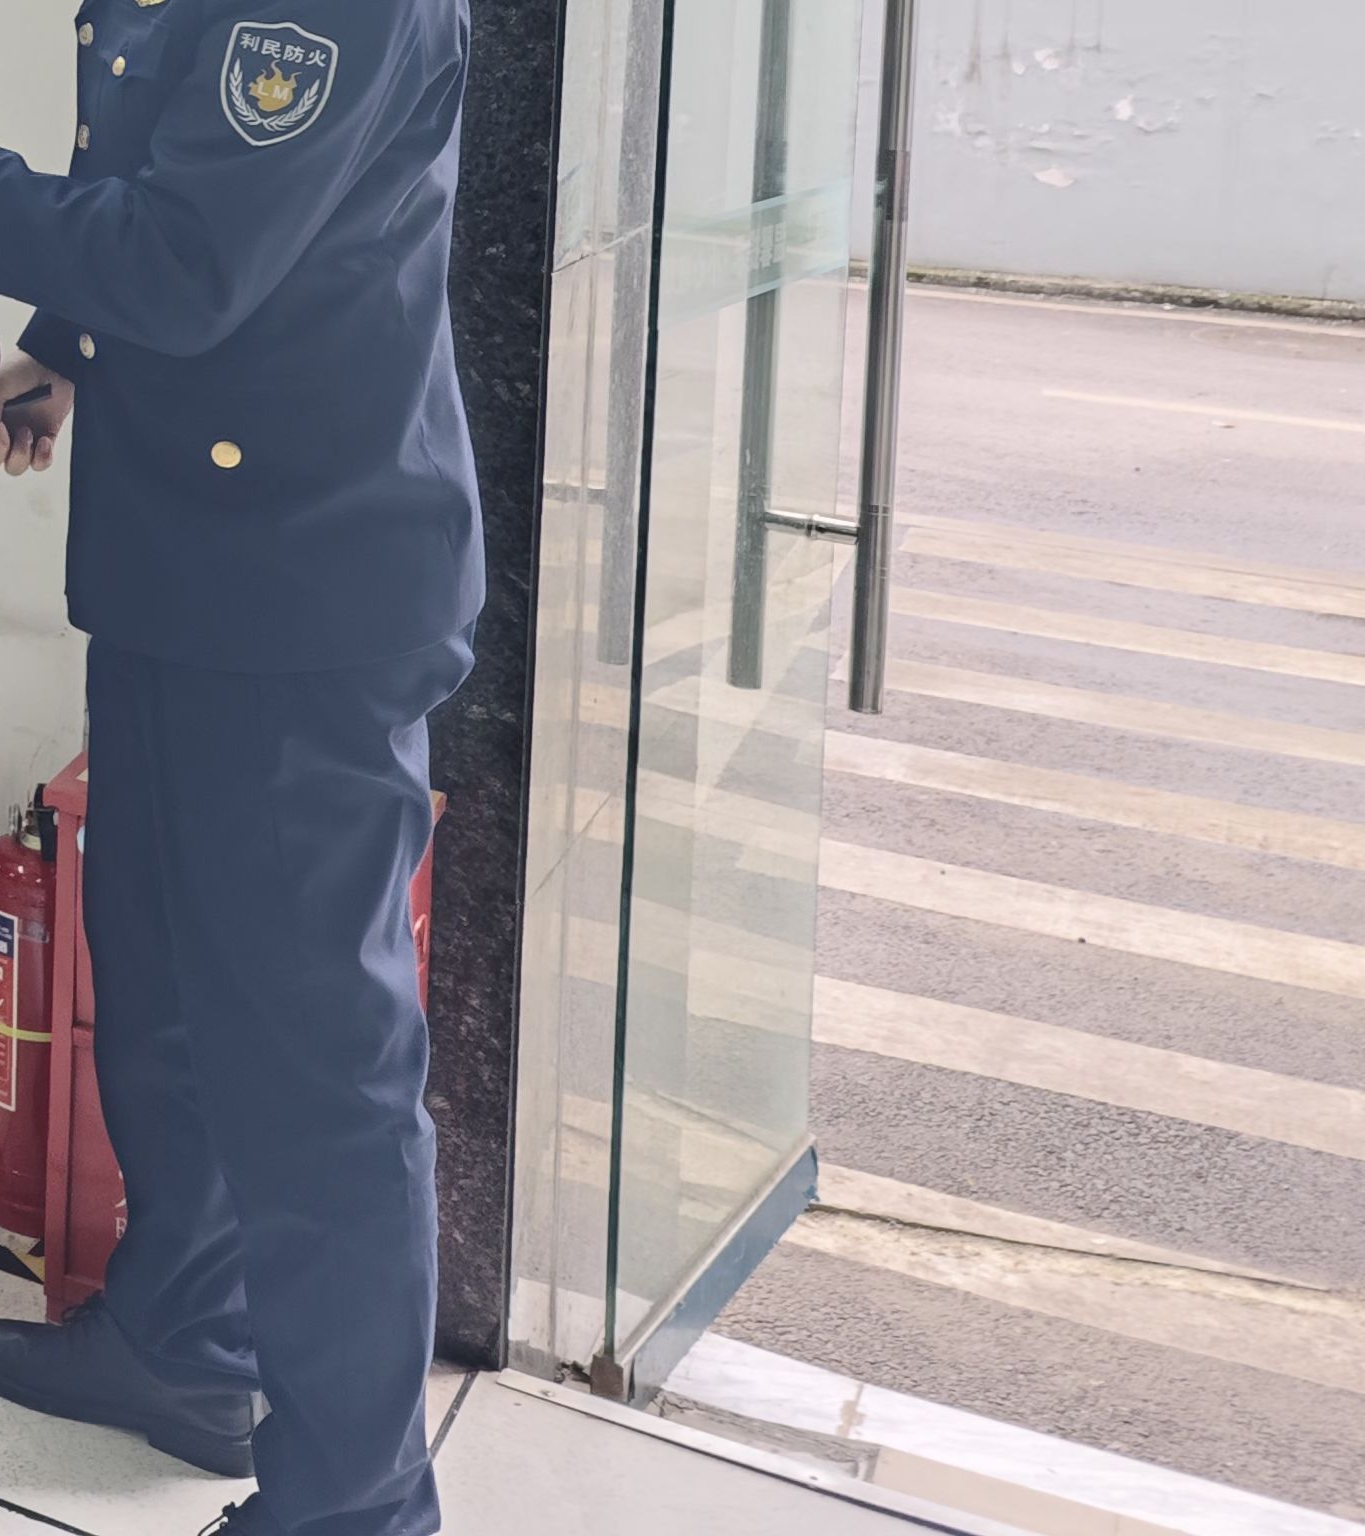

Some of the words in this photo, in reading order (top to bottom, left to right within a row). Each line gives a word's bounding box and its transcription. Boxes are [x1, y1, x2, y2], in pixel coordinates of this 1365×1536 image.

[240, 32, 327, 67] 利民防火
[257, 81, 290, 101] LM
